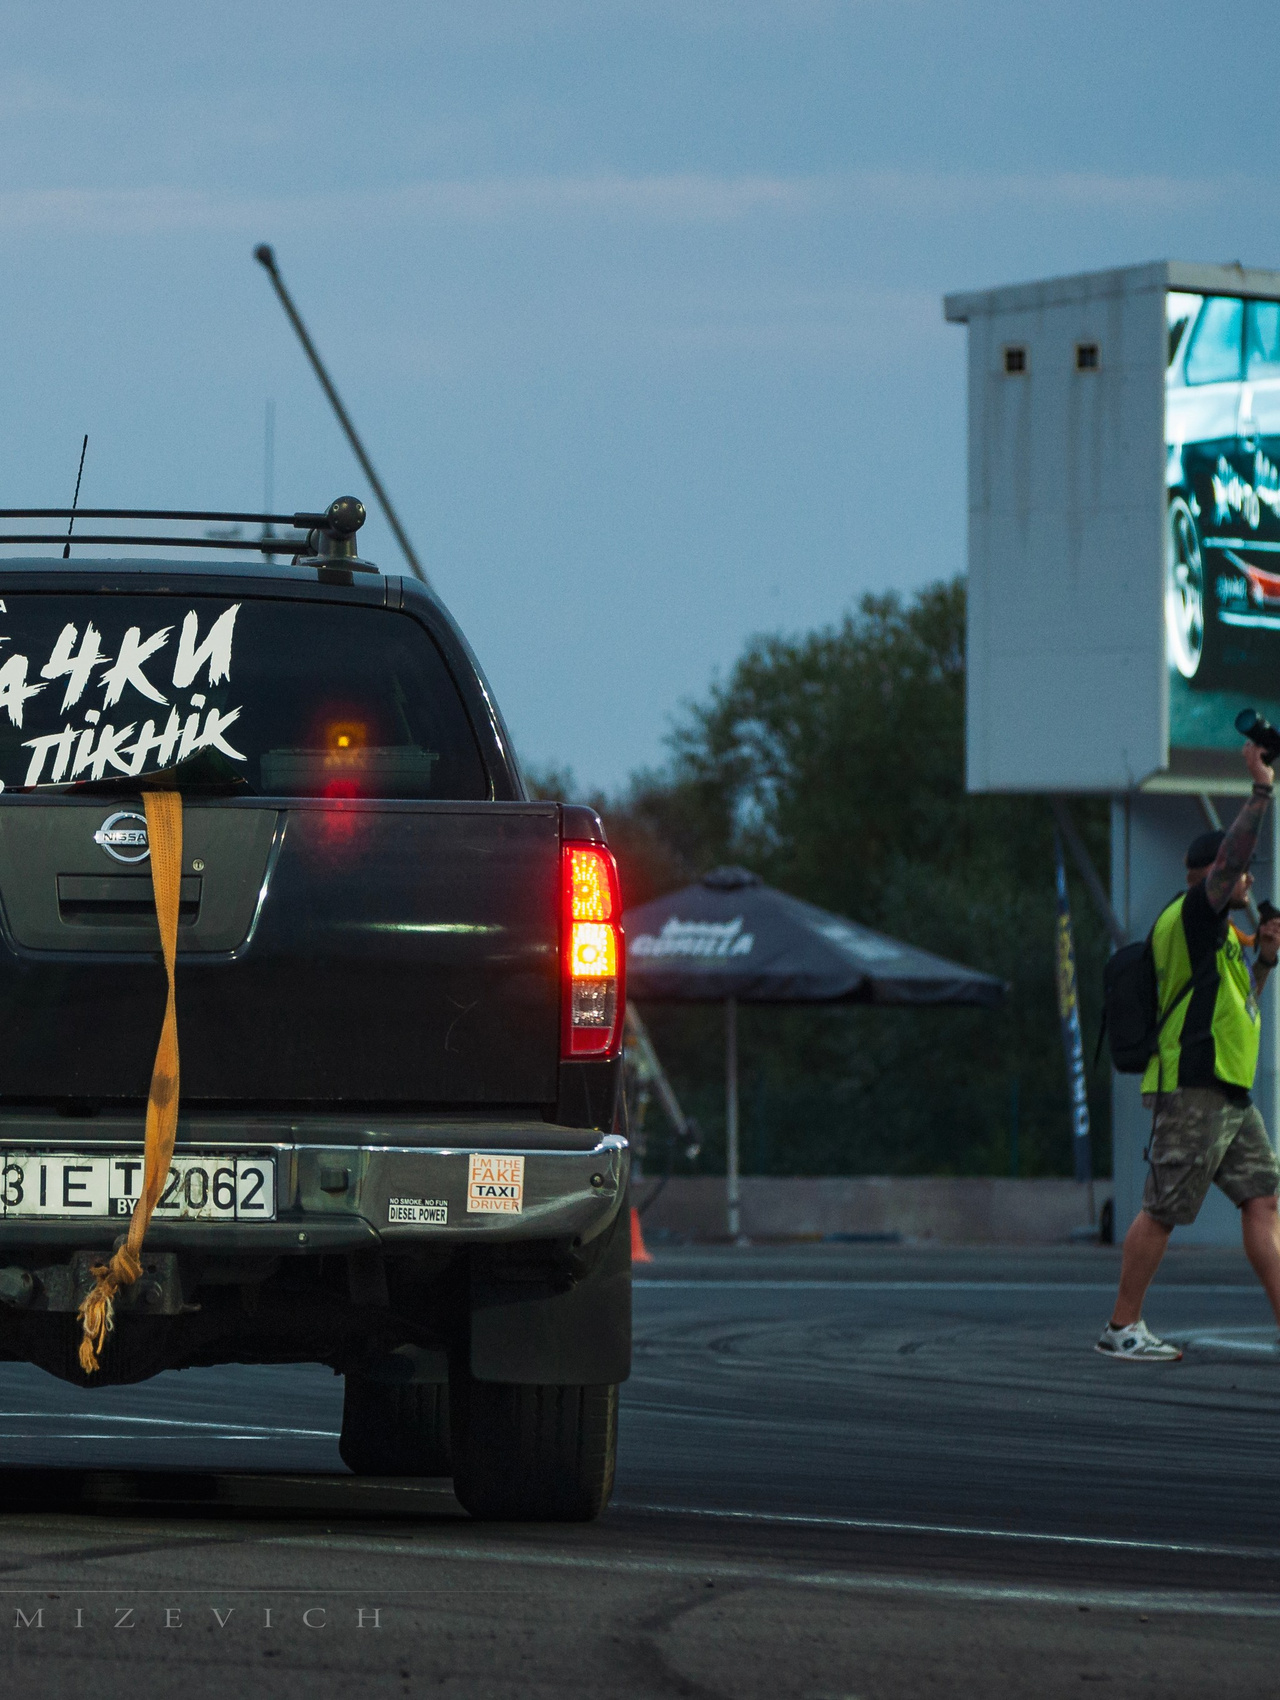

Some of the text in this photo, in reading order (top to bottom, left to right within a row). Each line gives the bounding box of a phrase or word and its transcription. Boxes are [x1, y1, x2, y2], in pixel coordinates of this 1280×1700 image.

[103, 832, 148, 842] NISSA
[472, 1158, 520, 1169] I'M THE
[472, 1168, 520, 1183] FAKE
[476, 1185, 515, 1198] TAXI
[117, 1198, 136, 1214] BY
[470, 1199, 519, 1211] DRIVER
[390, 1207, 446, 1221] DIESEL POWER
